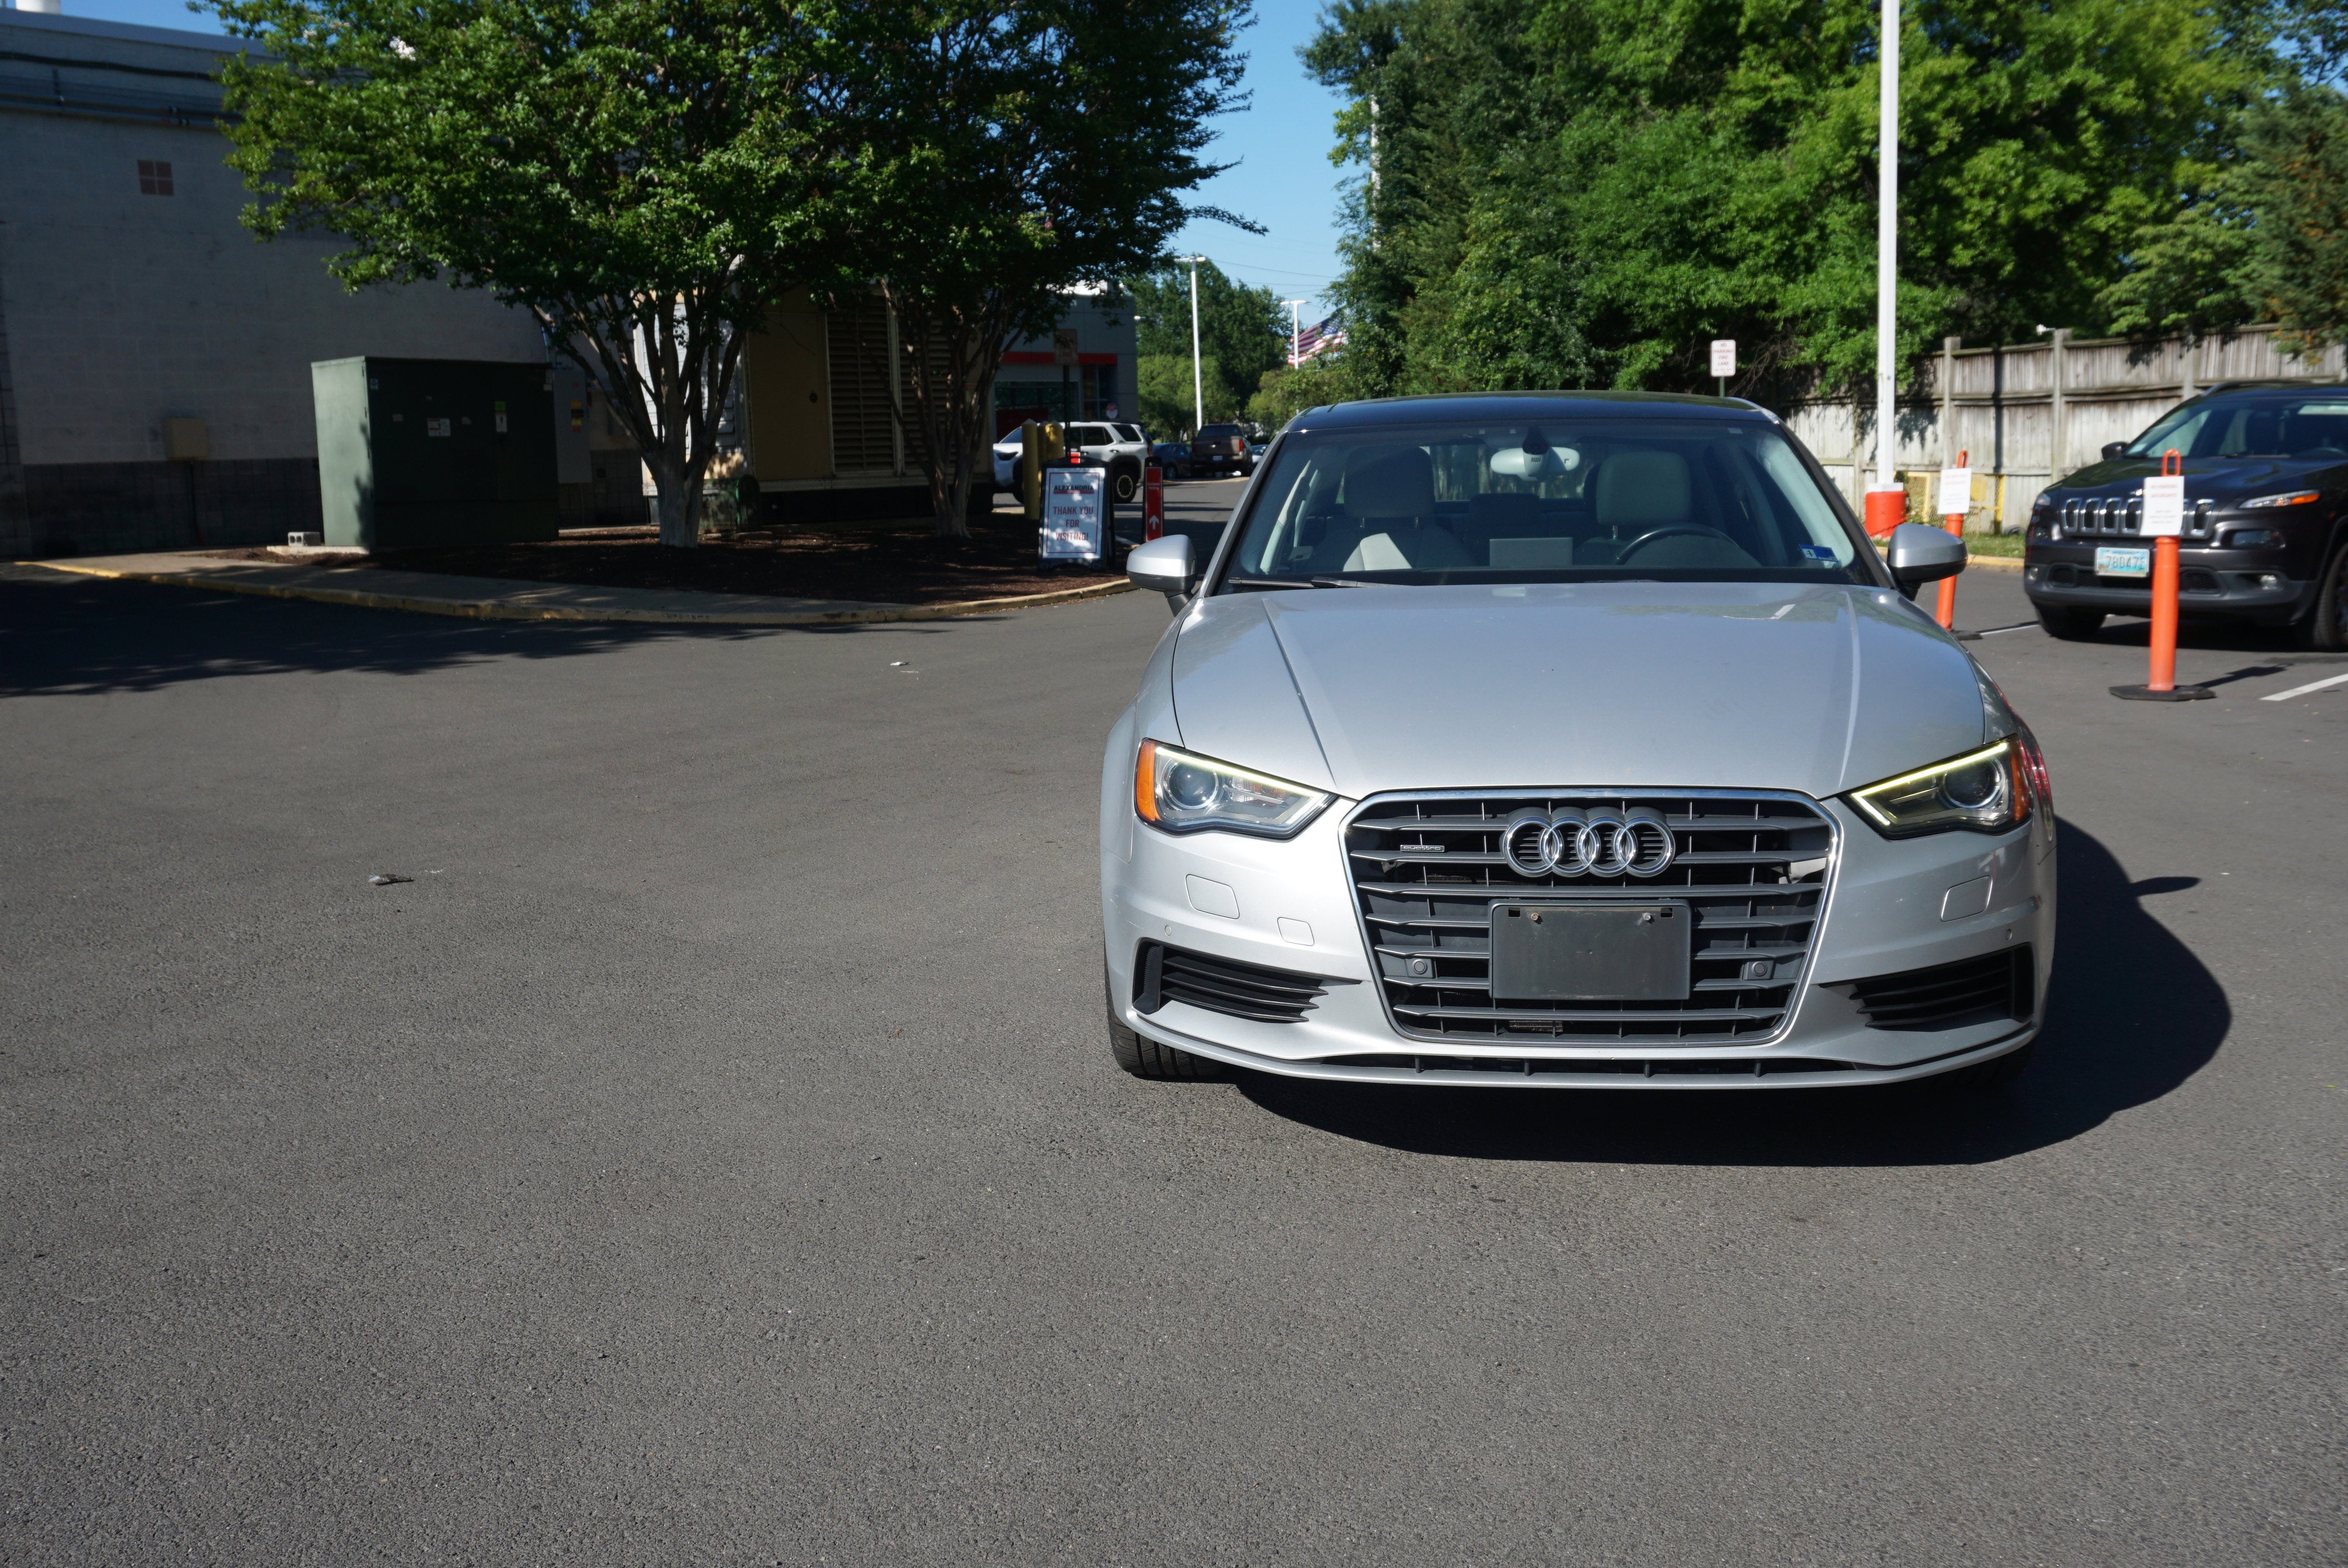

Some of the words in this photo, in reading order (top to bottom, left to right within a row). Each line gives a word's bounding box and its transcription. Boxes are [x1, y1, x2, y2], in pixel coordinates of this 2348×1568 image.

[1079, 506, 1094, 514] YOU
[1065, 519, 1079, 528] FOR
[1055, 532, 1089, 541] VISITING!
